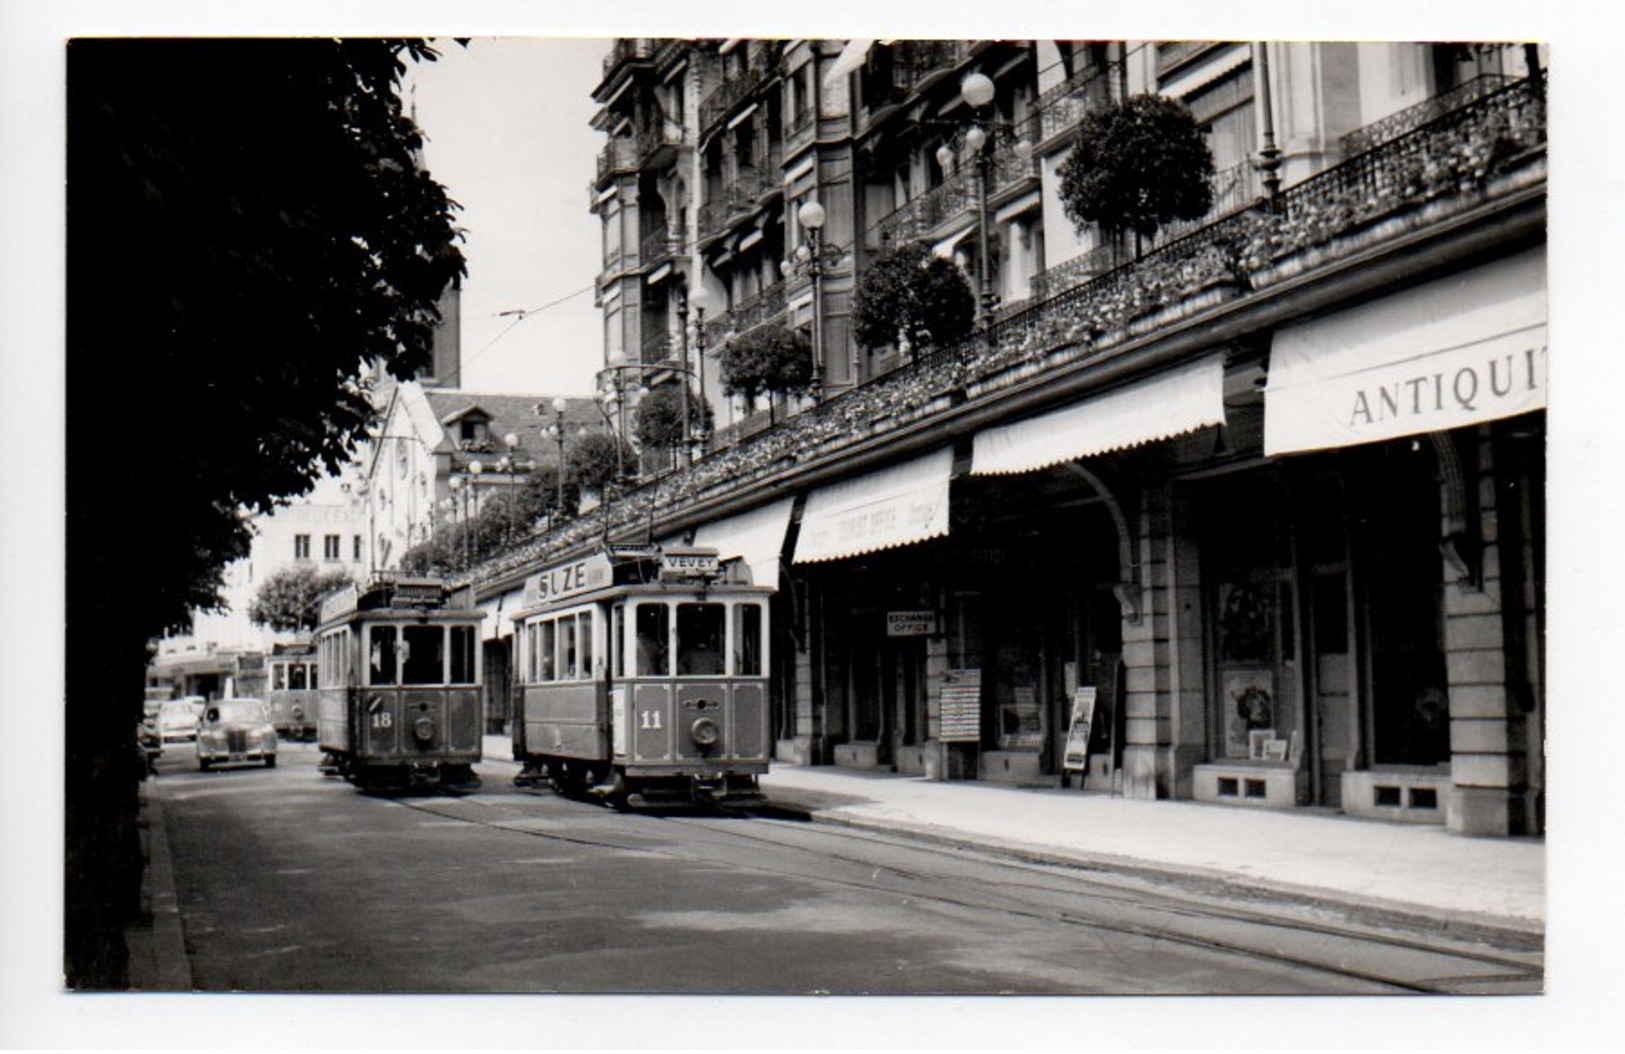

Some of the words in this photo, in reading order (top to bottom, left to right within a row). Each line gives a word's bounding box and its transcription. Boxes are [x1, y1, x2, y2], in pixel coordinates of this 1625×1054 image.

[668, 556, 714, 568] VEVEY
[889, 613, 933, 623] EXCHANGE
[894, 623, 928, 632] OFFICE
[372, 712, 392, 728] 18
[641, 710, 662, 729] 11
